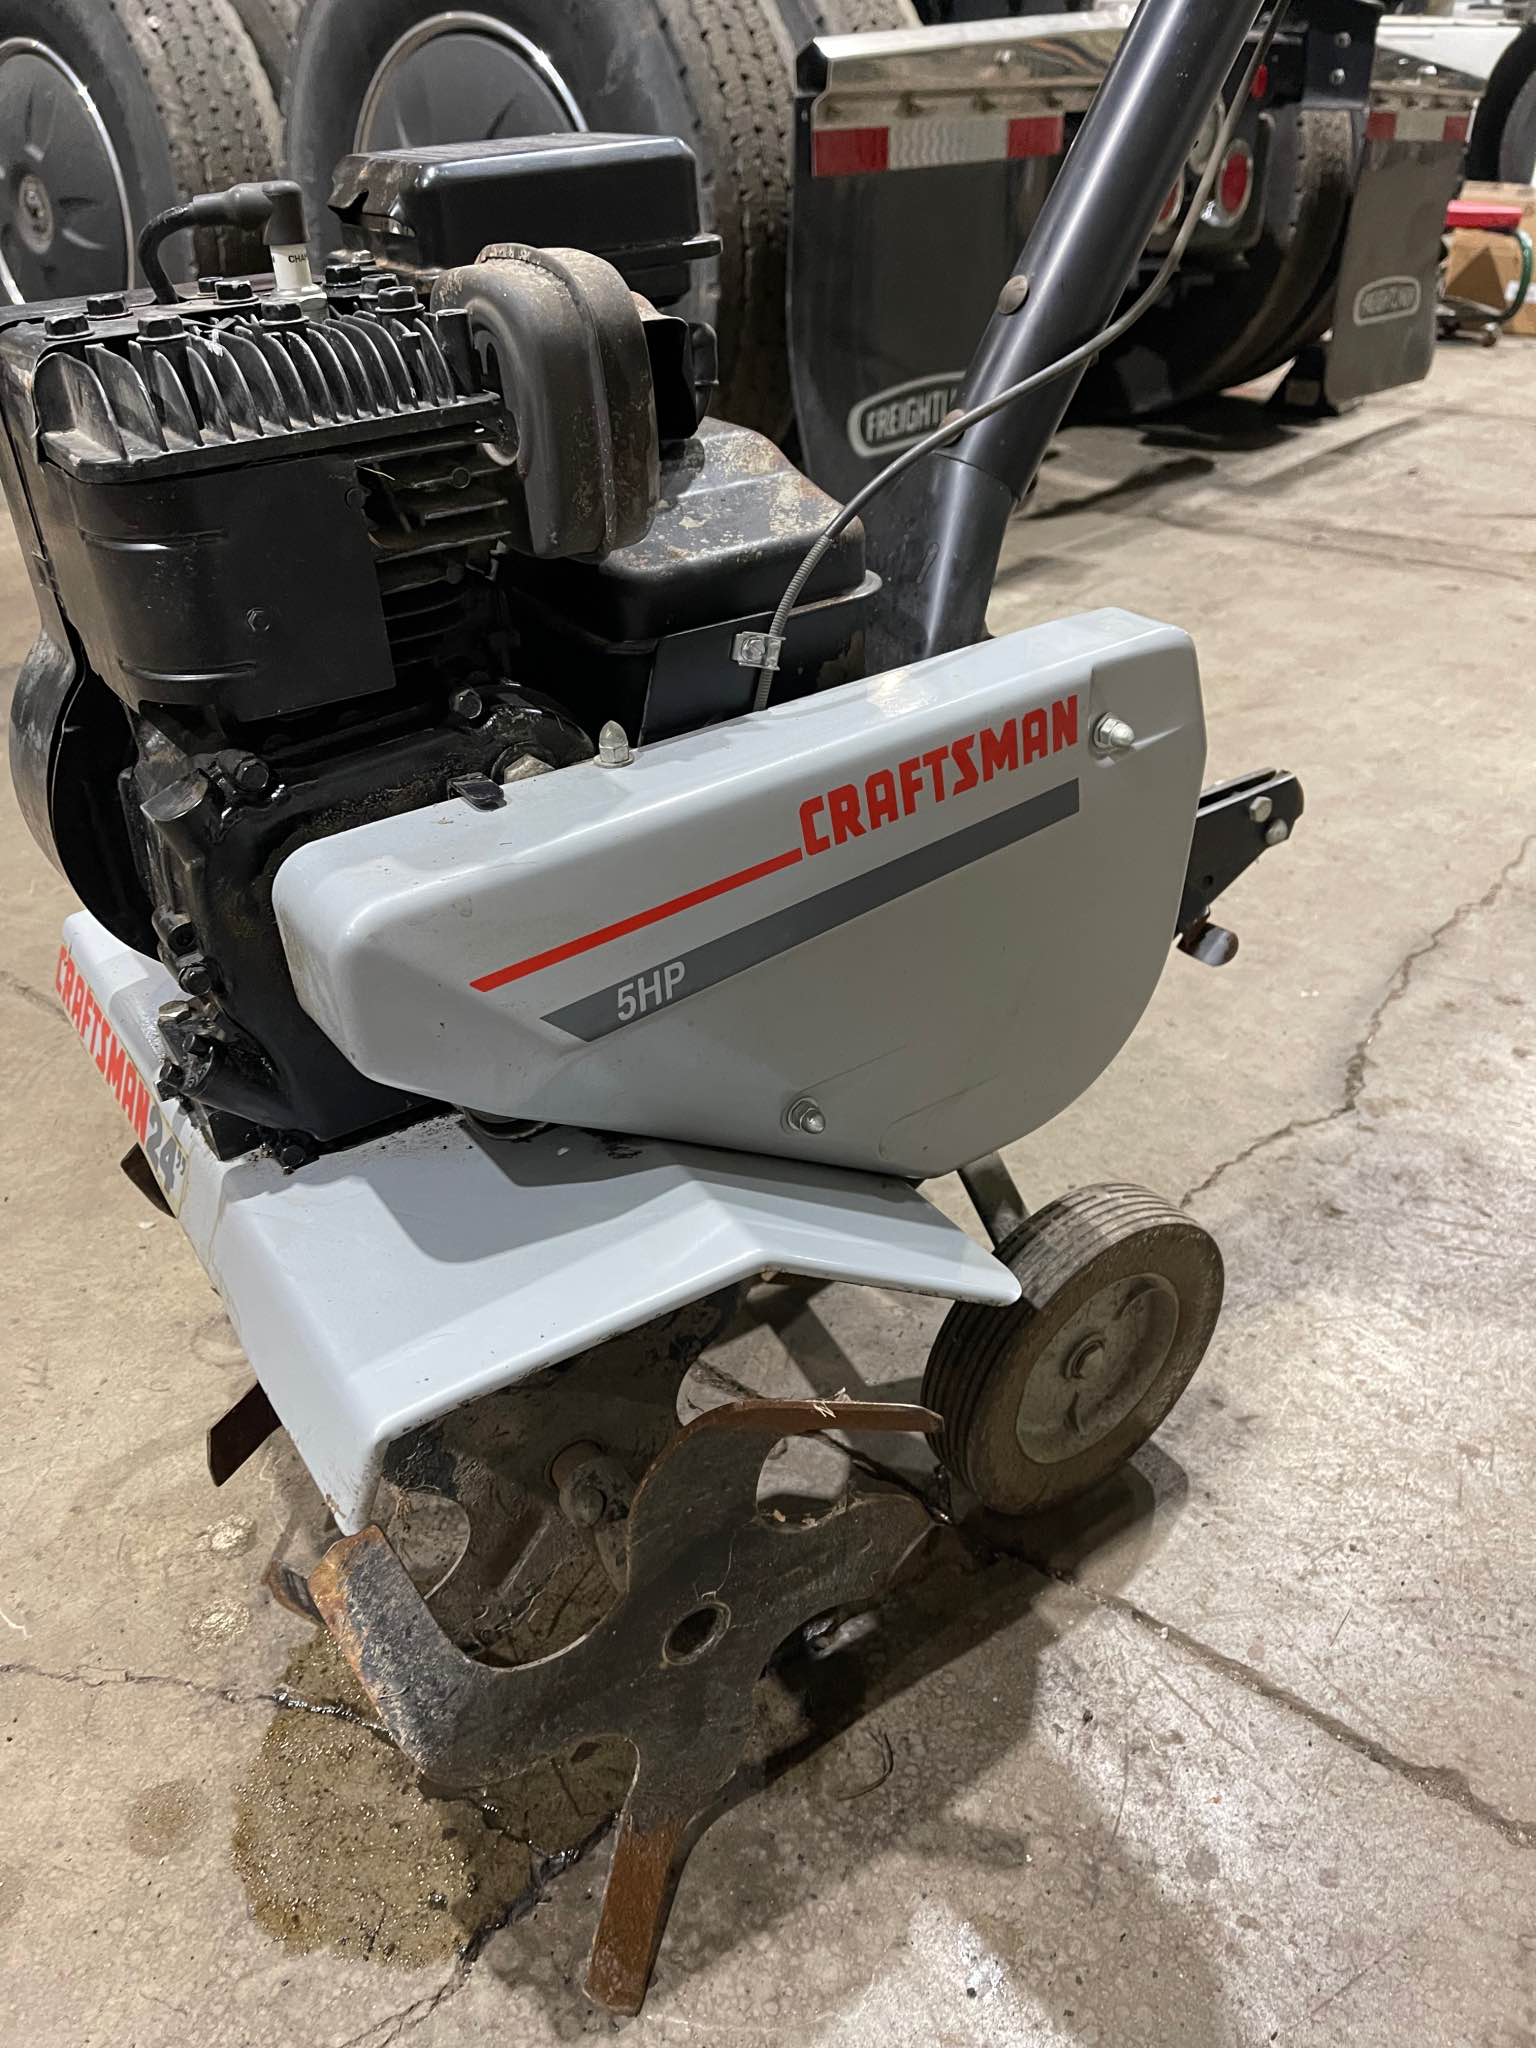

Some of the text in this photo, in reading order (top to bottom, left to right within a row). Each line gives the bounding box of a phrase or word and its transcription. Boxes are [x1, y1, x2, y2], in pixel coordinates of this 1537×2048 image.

[799, 694, 1078, 856] CRAFTSMAN
[56, 944, 150, 1147] CRAFTSMAN
[617, 960, 685, 1021] 5HP
